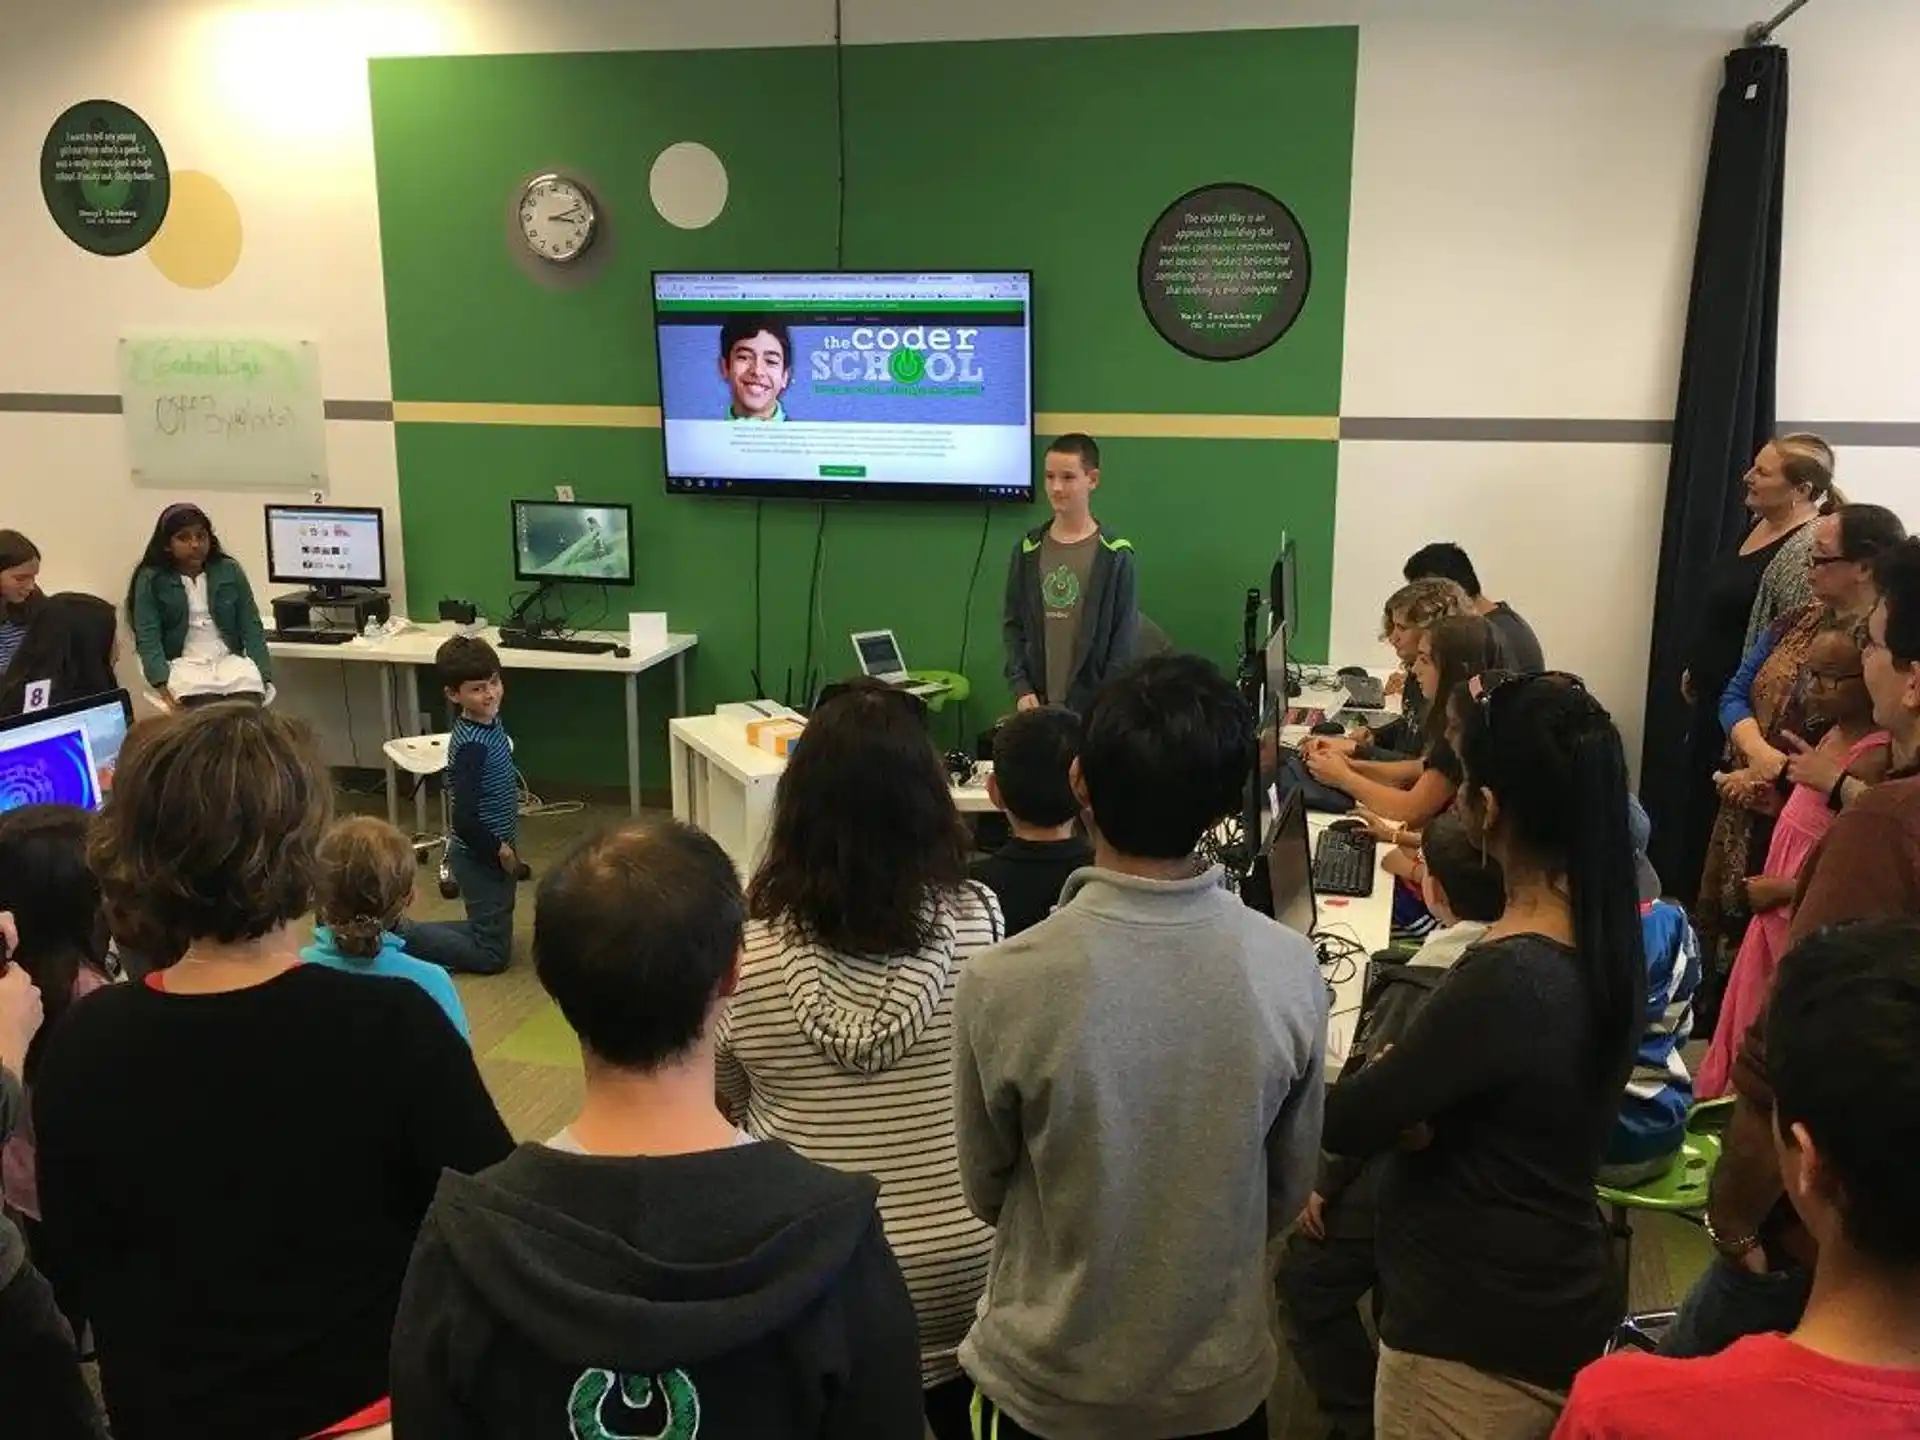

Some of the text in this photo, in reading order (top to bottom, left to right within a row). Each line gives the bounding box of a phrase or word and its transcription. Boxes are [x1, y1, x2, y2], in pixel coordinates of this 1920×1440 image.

[823, 326, 979, 350] the coder
[810, 348, 985, 384] SCHOOL
[313, 491, 323, 504] 2
[30, 687, 43, 706] 8
